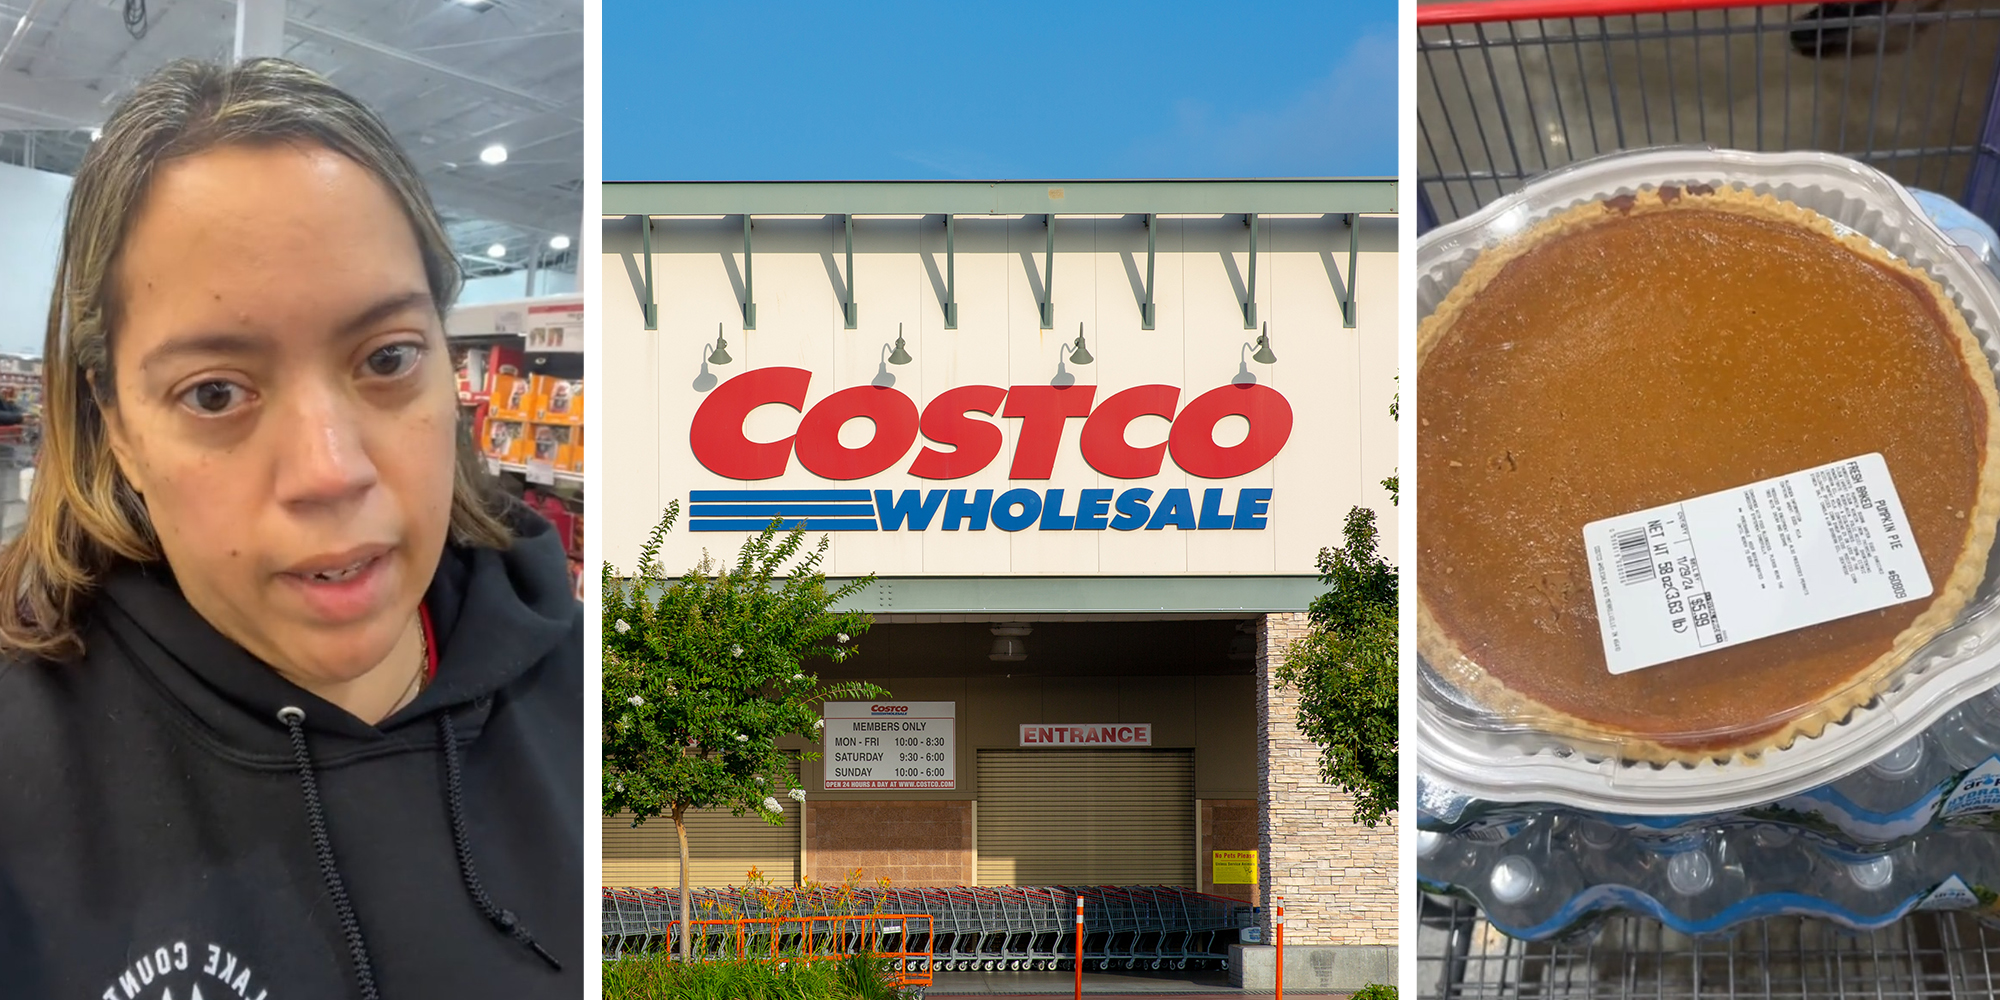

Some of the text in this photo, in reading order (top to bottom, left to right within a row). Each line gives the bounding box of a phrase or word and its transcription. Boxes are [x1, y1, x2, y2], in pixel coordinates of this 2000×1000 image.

[690, 367, 1293, 481] COSTCO
[1845, 459, 1874, 510] FRESH BAKED
[873, 488, 1273, 531] WHOLESALE
[1647, 518, 1665, 538] NET
[1873, 498, 1904, 551] PUMPKIN PIE
[1652, 541, 1670, 556] WT
[1675, 554, 1694, 591] 11/29/24
[1688, 555, 1701, 573] SELL
[1689, 596, 1711, 628] $5.99
[853, 722, 927, 731] MEMBERS ONLY
[1024, 727, 1147, 743] ENTRANCE
[835, 737, 856, 746] MON
[865, 737, 879, 746] FRI
[895, 737, 918, 746] 10:00
[926, 737, 945, 746] 8:30
[835, 752, 884, 761] SATURDAY
[899, 752, 918, 761] 9:30
[925, 752, 945, 761] 6:00
[835, 767, 873, 777] SUNDAY
[895, 767, 918, 777] 10:00
[925, 767, 945, 777] 6:00
